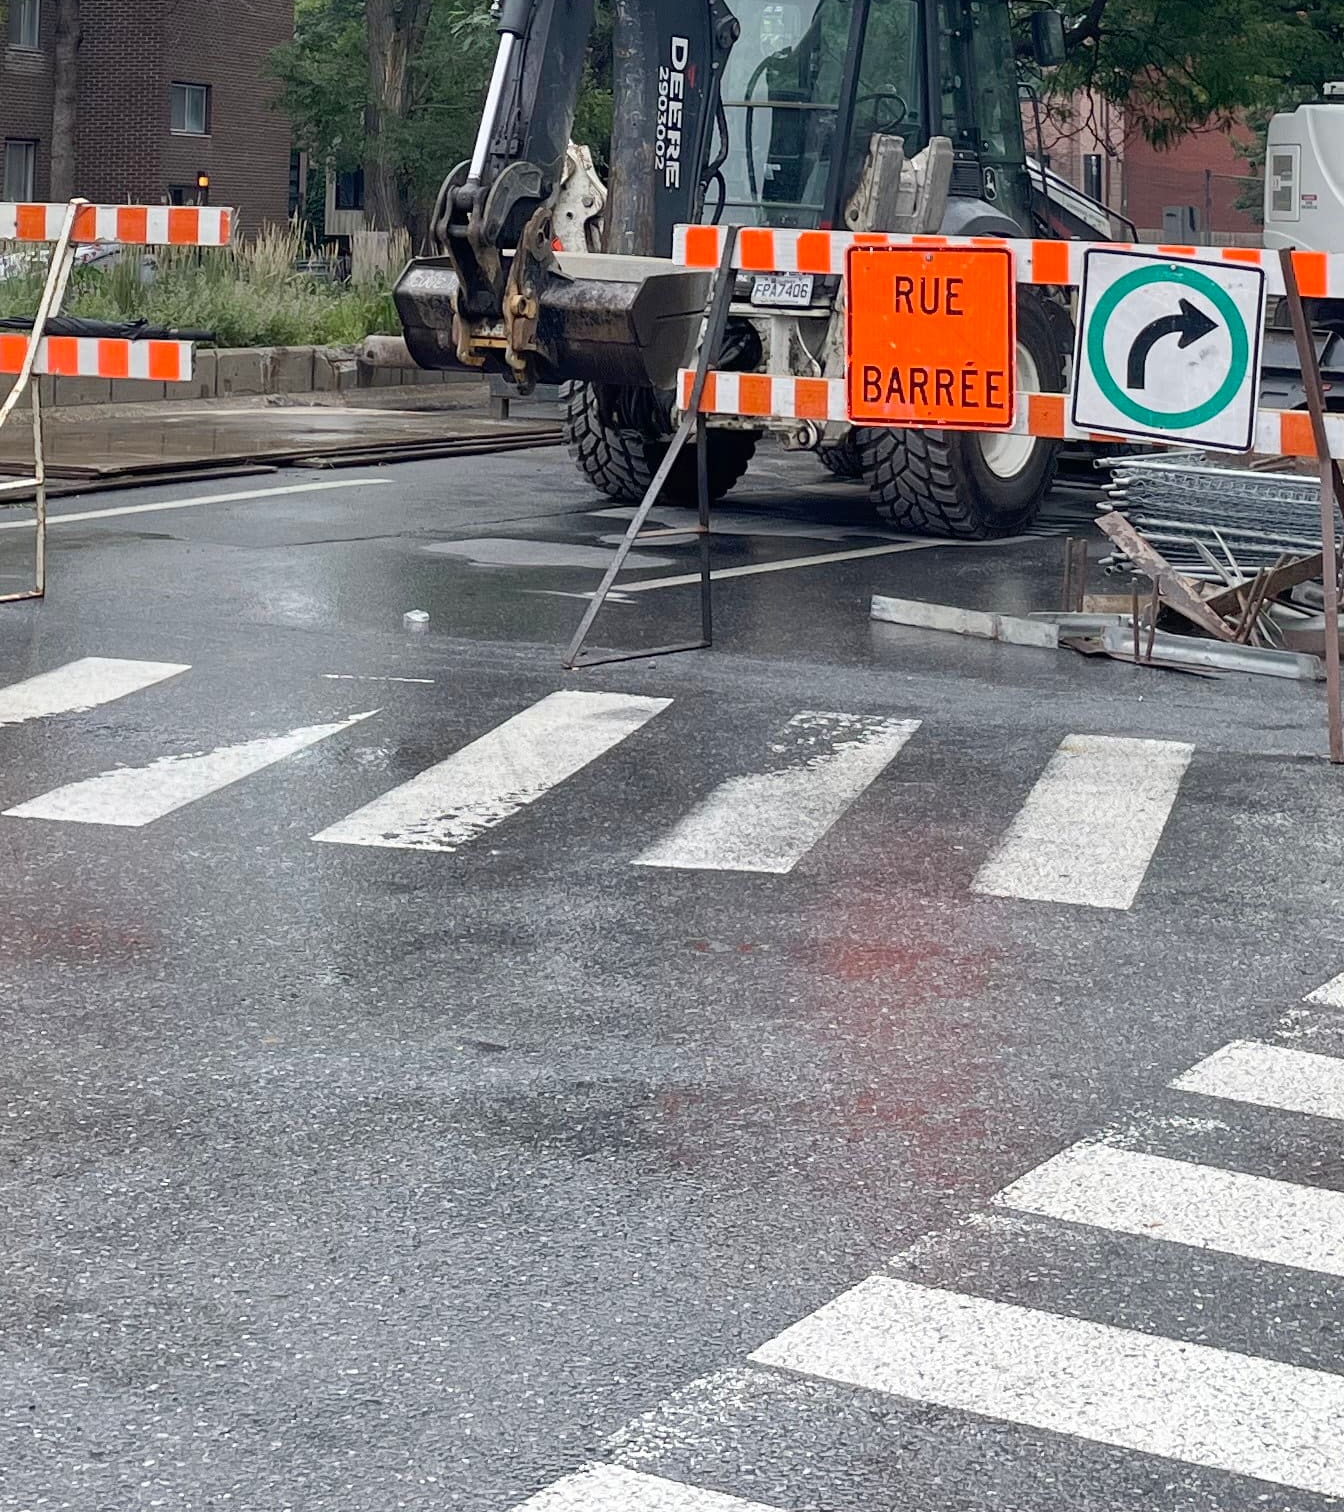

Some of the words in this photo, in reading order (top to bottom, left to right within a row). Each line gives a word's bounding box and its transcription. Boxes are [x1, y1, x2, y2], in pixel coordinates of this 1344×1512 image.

[655, 66, 669, 170] 2903002
[665, 36, 689, 188] DEERE
[754, 283, 809, 298] FPA7406
[895, 275, 964, 316] RUE
[863, 361, 1005, 409] BARRÉE
